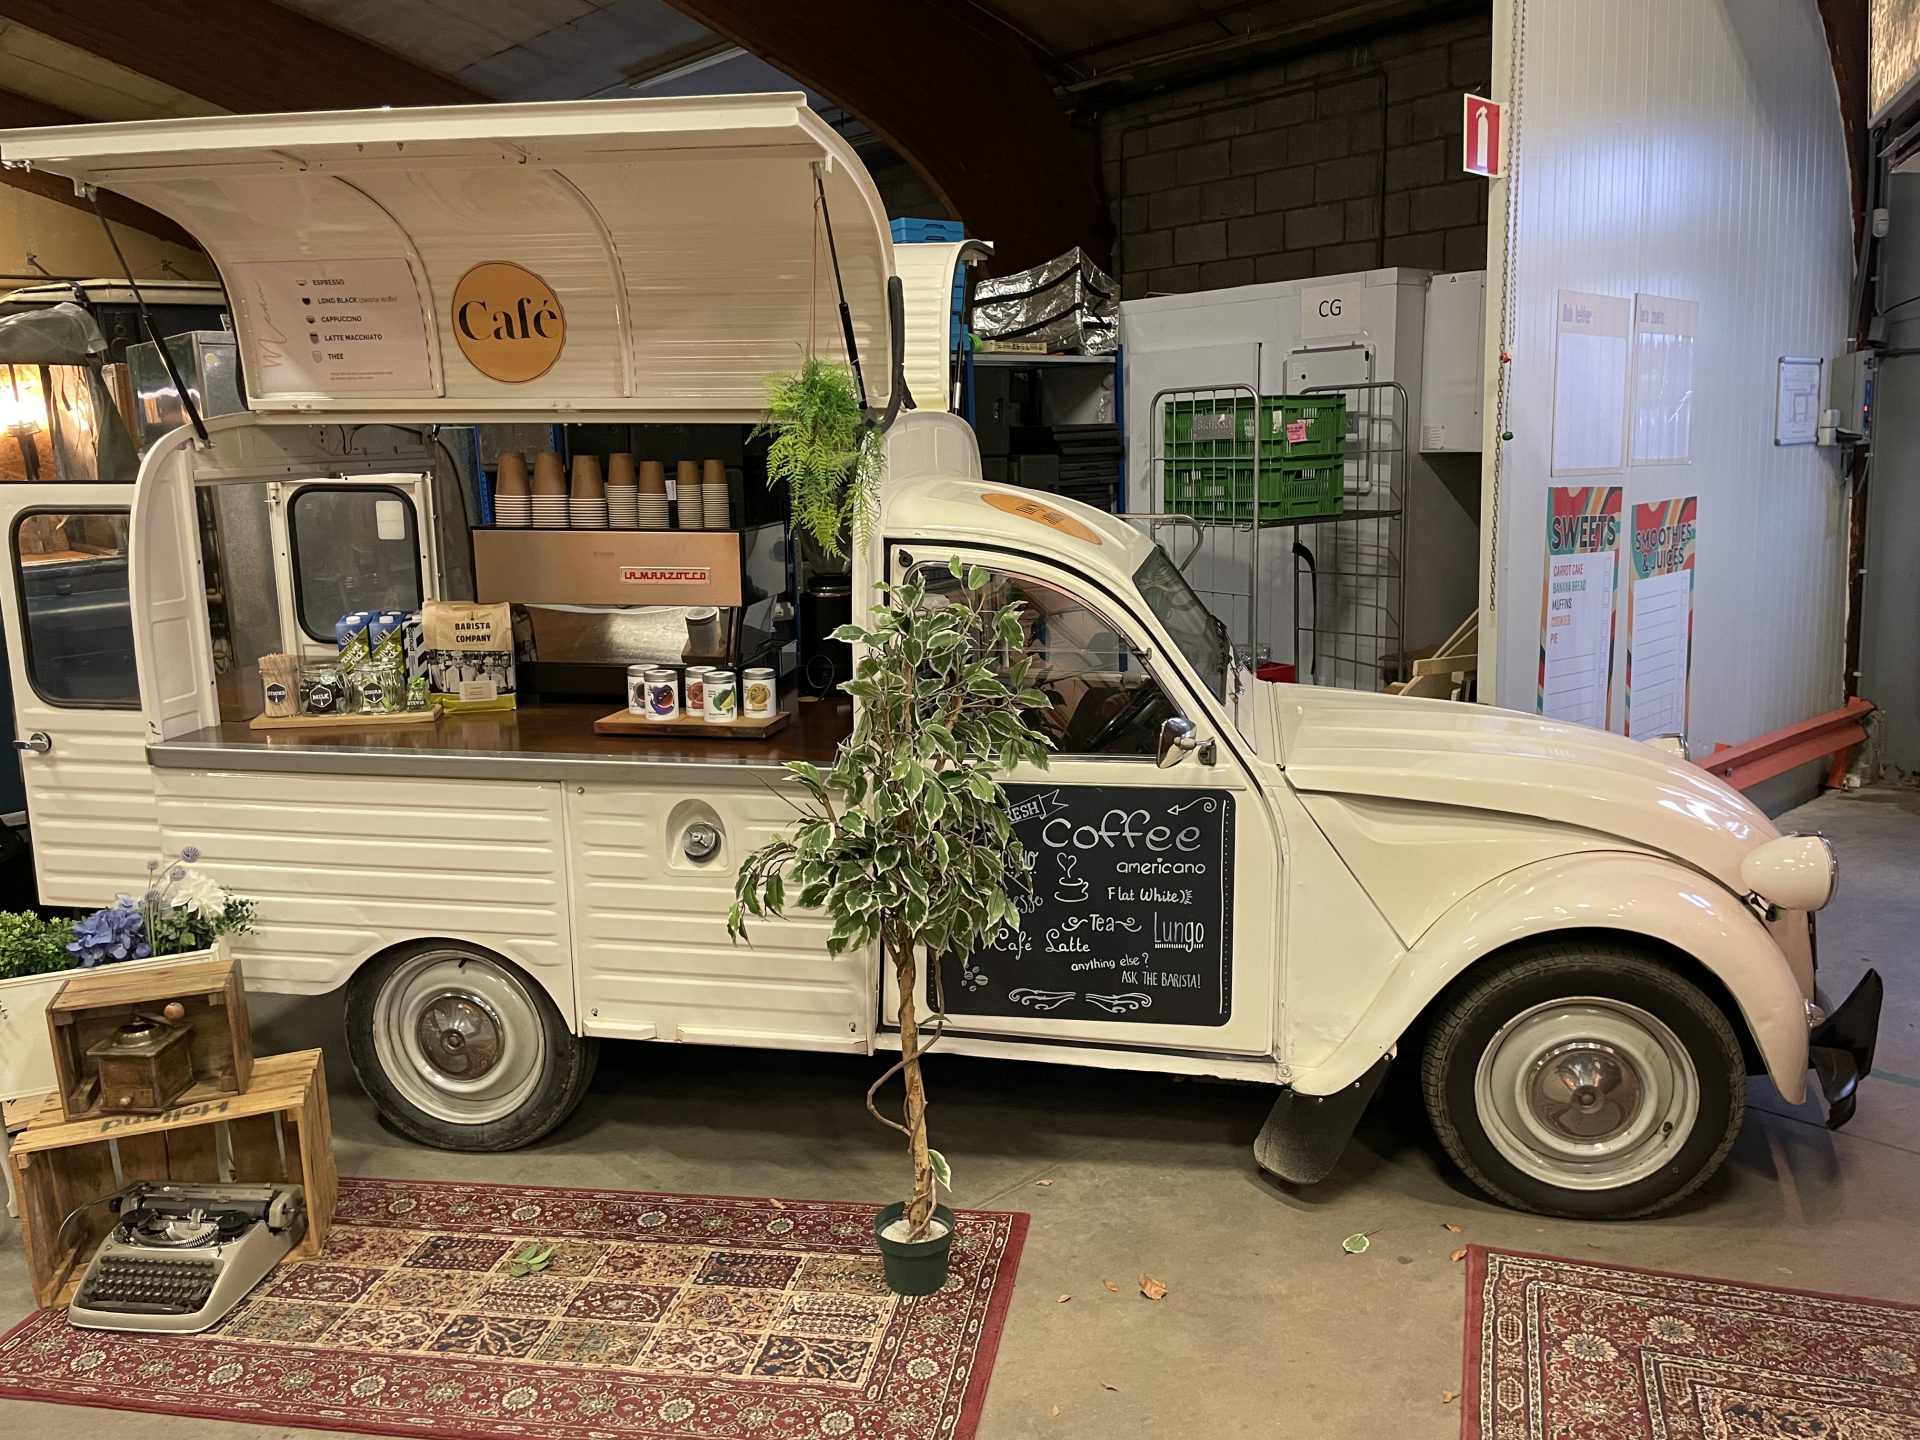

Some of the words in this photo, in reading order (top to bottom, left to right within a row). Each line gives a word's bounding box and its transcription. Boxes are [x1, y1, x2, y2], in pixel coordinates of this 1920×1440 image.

[1318, 299, 1342, 317] CG
[458, 297, 558, 341] Café
[1552, 515, 1616, 549] SWEETS
[1635, 523, 1691, 551] SMOOTHIES
[1643, 554, 1650, 572] &
[1651, 547, 1684, 570] JUICES
[1554, 564, 1572, 577] CARROT
[1572, 563, 1584, 575] CAKE
[1553, 581, 1571, 593] BANANA
[1572, 580, 1586, 592] BREAD
[1552, 598, 1572, 610] MUFFINS
[455, 622, 491, 630] BARISTA
[1551, 615, 1571, 627] COOKIES
[456, 634, 491, 642] COMPANY
[1006, 800, 1041, 823] RESH
[1042, 809, 1201, 851] Coffee
[1116, 858, 1206, 875] americano
[1107, 887, 1135, 902] Flat
[1140, 888, 1178, 903] White
[1089, 914, 1115, 932] Tea
[1154, 911, 1205, 952] Lungo
[993, 928, 1033, 960] Café
[1045, 928, 1091, 953] Latte
[1071, 958, 1116, 971] anything
[1121, 970, 1138, 985] ASK
[1142, 971, 1158, 986] THE
[1161, 972, 1201, 989] BARISTA!
